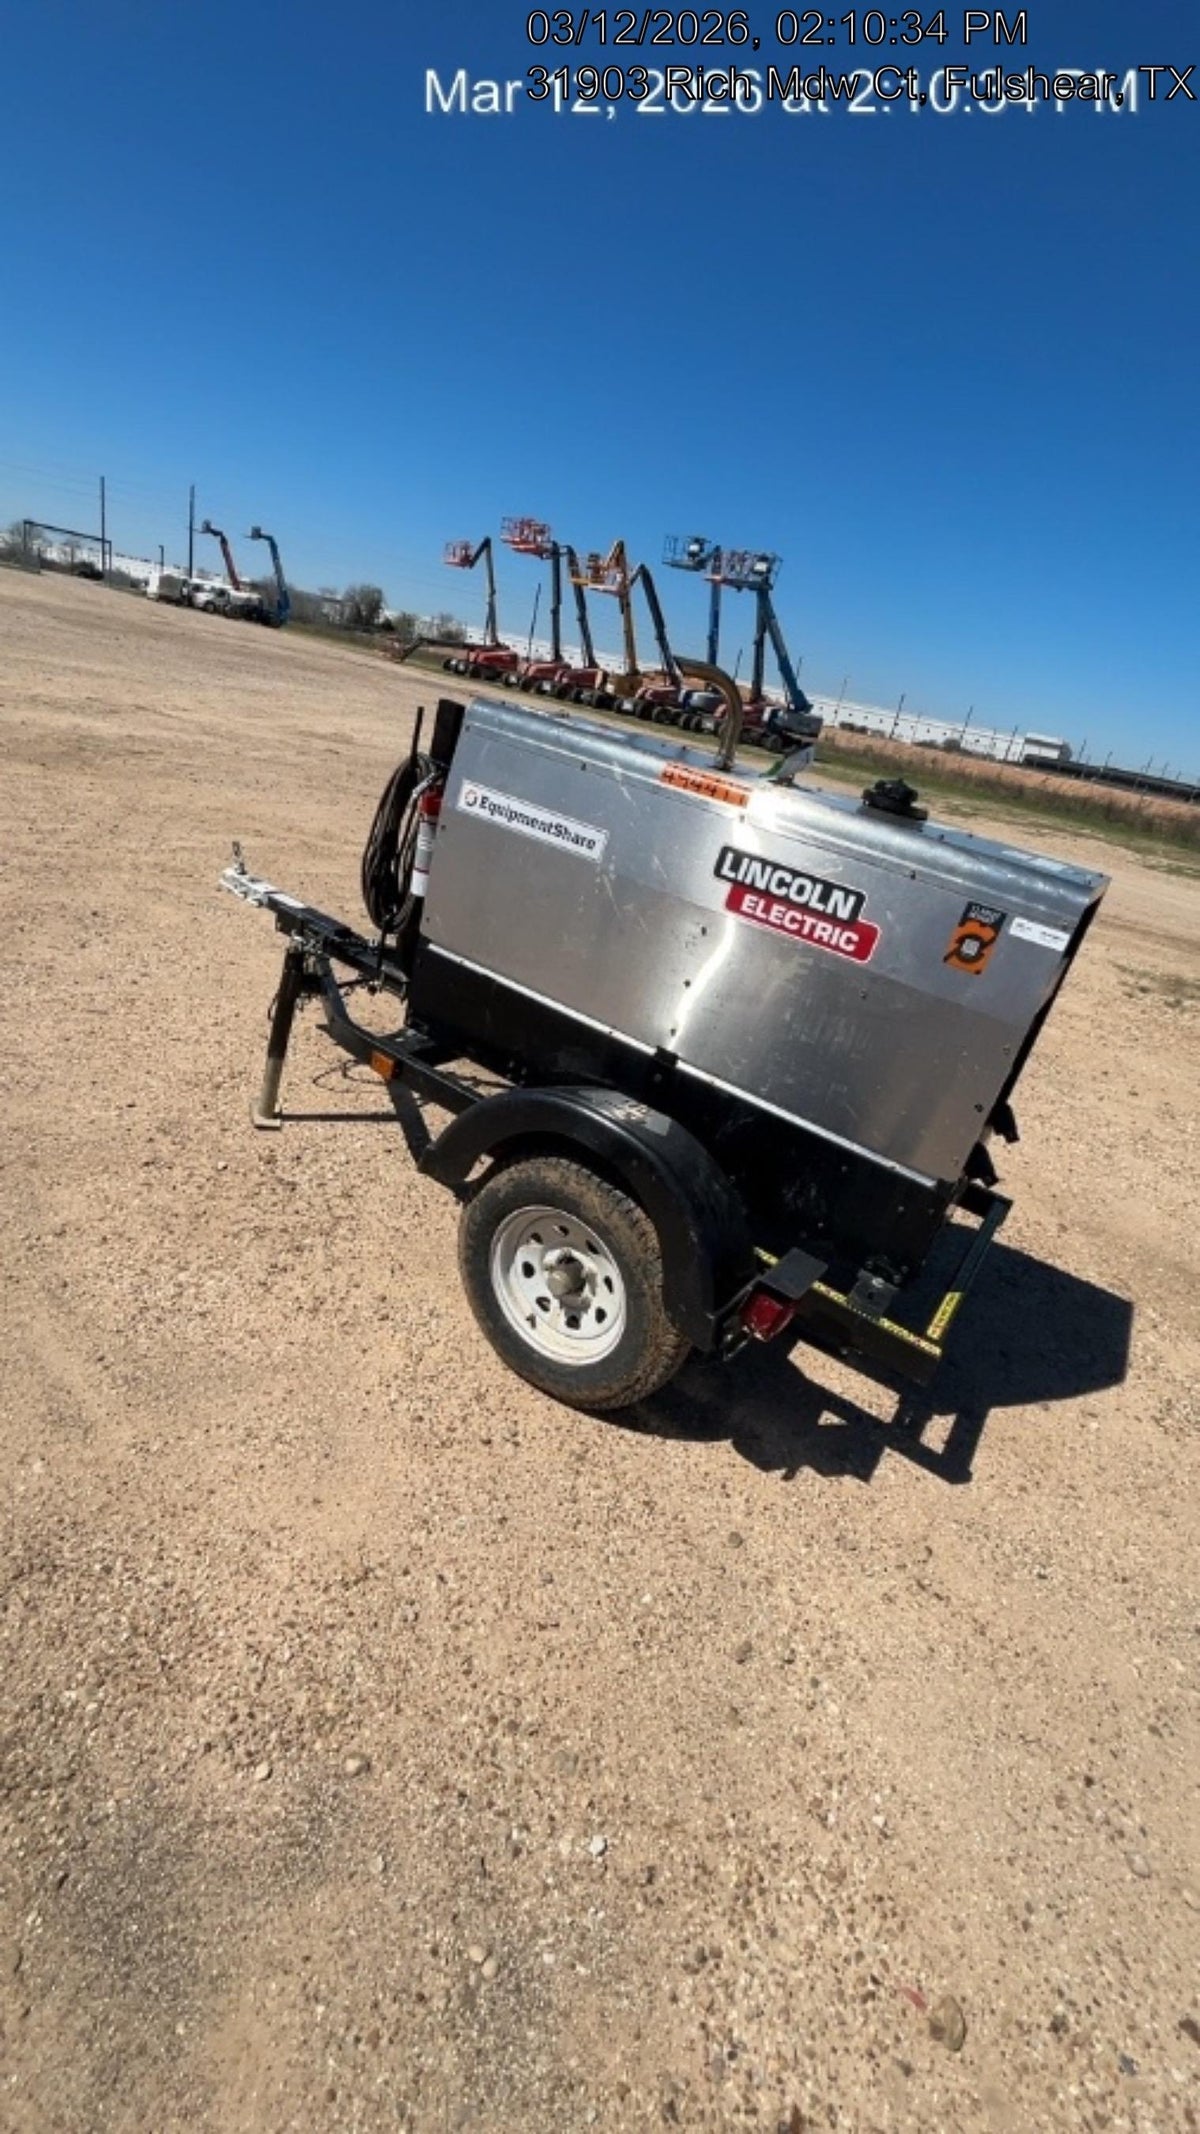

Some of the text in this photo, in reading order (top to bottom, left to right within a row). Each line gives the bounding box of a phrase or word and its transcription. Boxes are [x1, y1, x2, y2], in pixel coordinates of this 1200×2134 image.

[479, 795, 597, 850] EquipmentShare
[720, 852, 858, 922] LINCOLN
[739, 893, 860, 952] ELECTRIC
